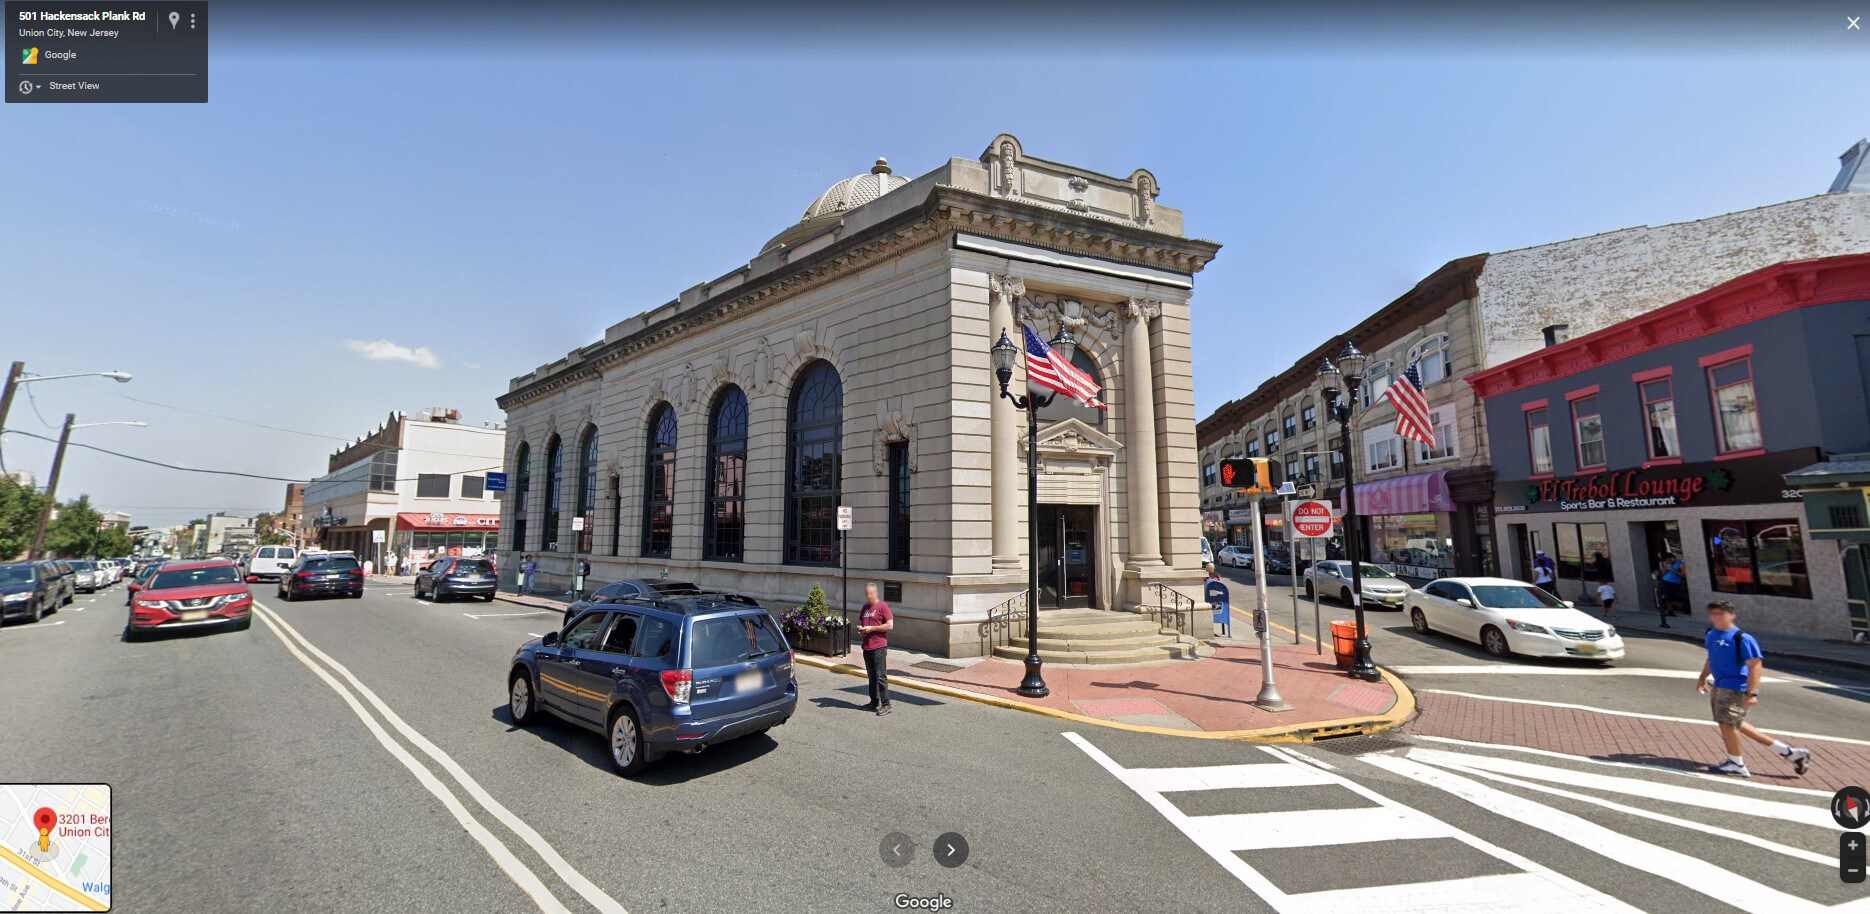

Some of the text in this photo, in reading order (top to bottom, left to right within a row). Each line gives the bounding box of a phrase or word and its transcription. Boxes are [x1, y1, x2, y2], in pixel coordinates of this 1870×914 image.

[1539, 470, 1703, 502] El Trebol Lounge
[1298, 507, 1325, 515] DO NOT
[1560, 495, 1676, 511] Sports Bar & Restaurant
